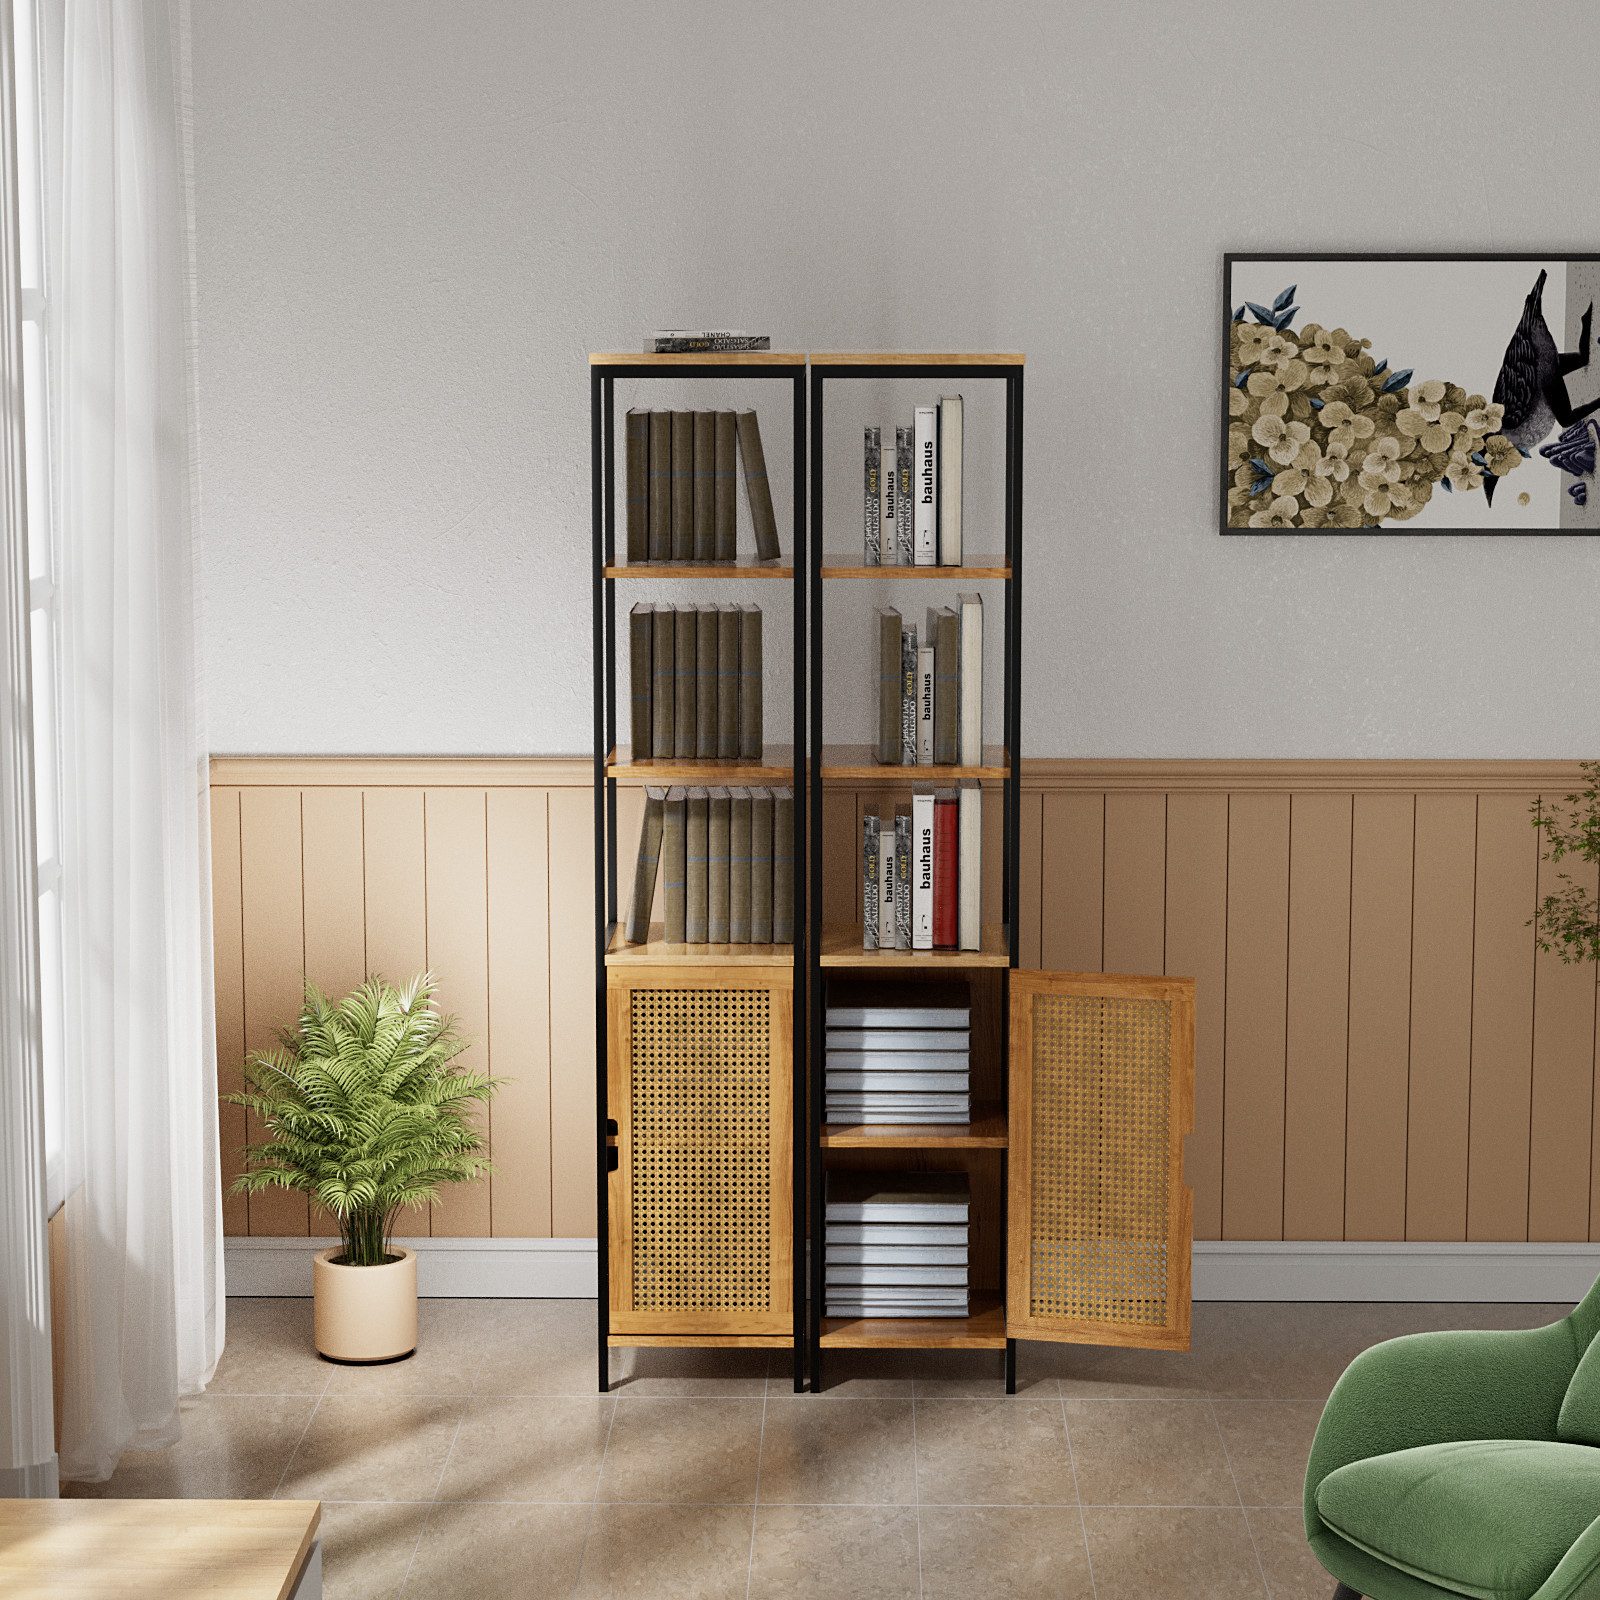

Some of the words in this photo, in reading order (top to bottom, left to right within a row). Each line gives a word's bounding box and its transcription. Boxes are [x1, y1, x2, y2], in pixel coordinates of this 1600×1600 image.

[869, 469, 877, 493] GOLD
[885, 471, 894, 519] bauhaus
[921, 441, 933, 504] bauhaus
[872, 498, 880, 540] SALGADO
[904, 498, 912, 540] SALGADO
[922, 673, 931, 721] bauhaus
[884, 856, 893, 903] bauhaus
[919, 828, 931, 889] bauhaus
